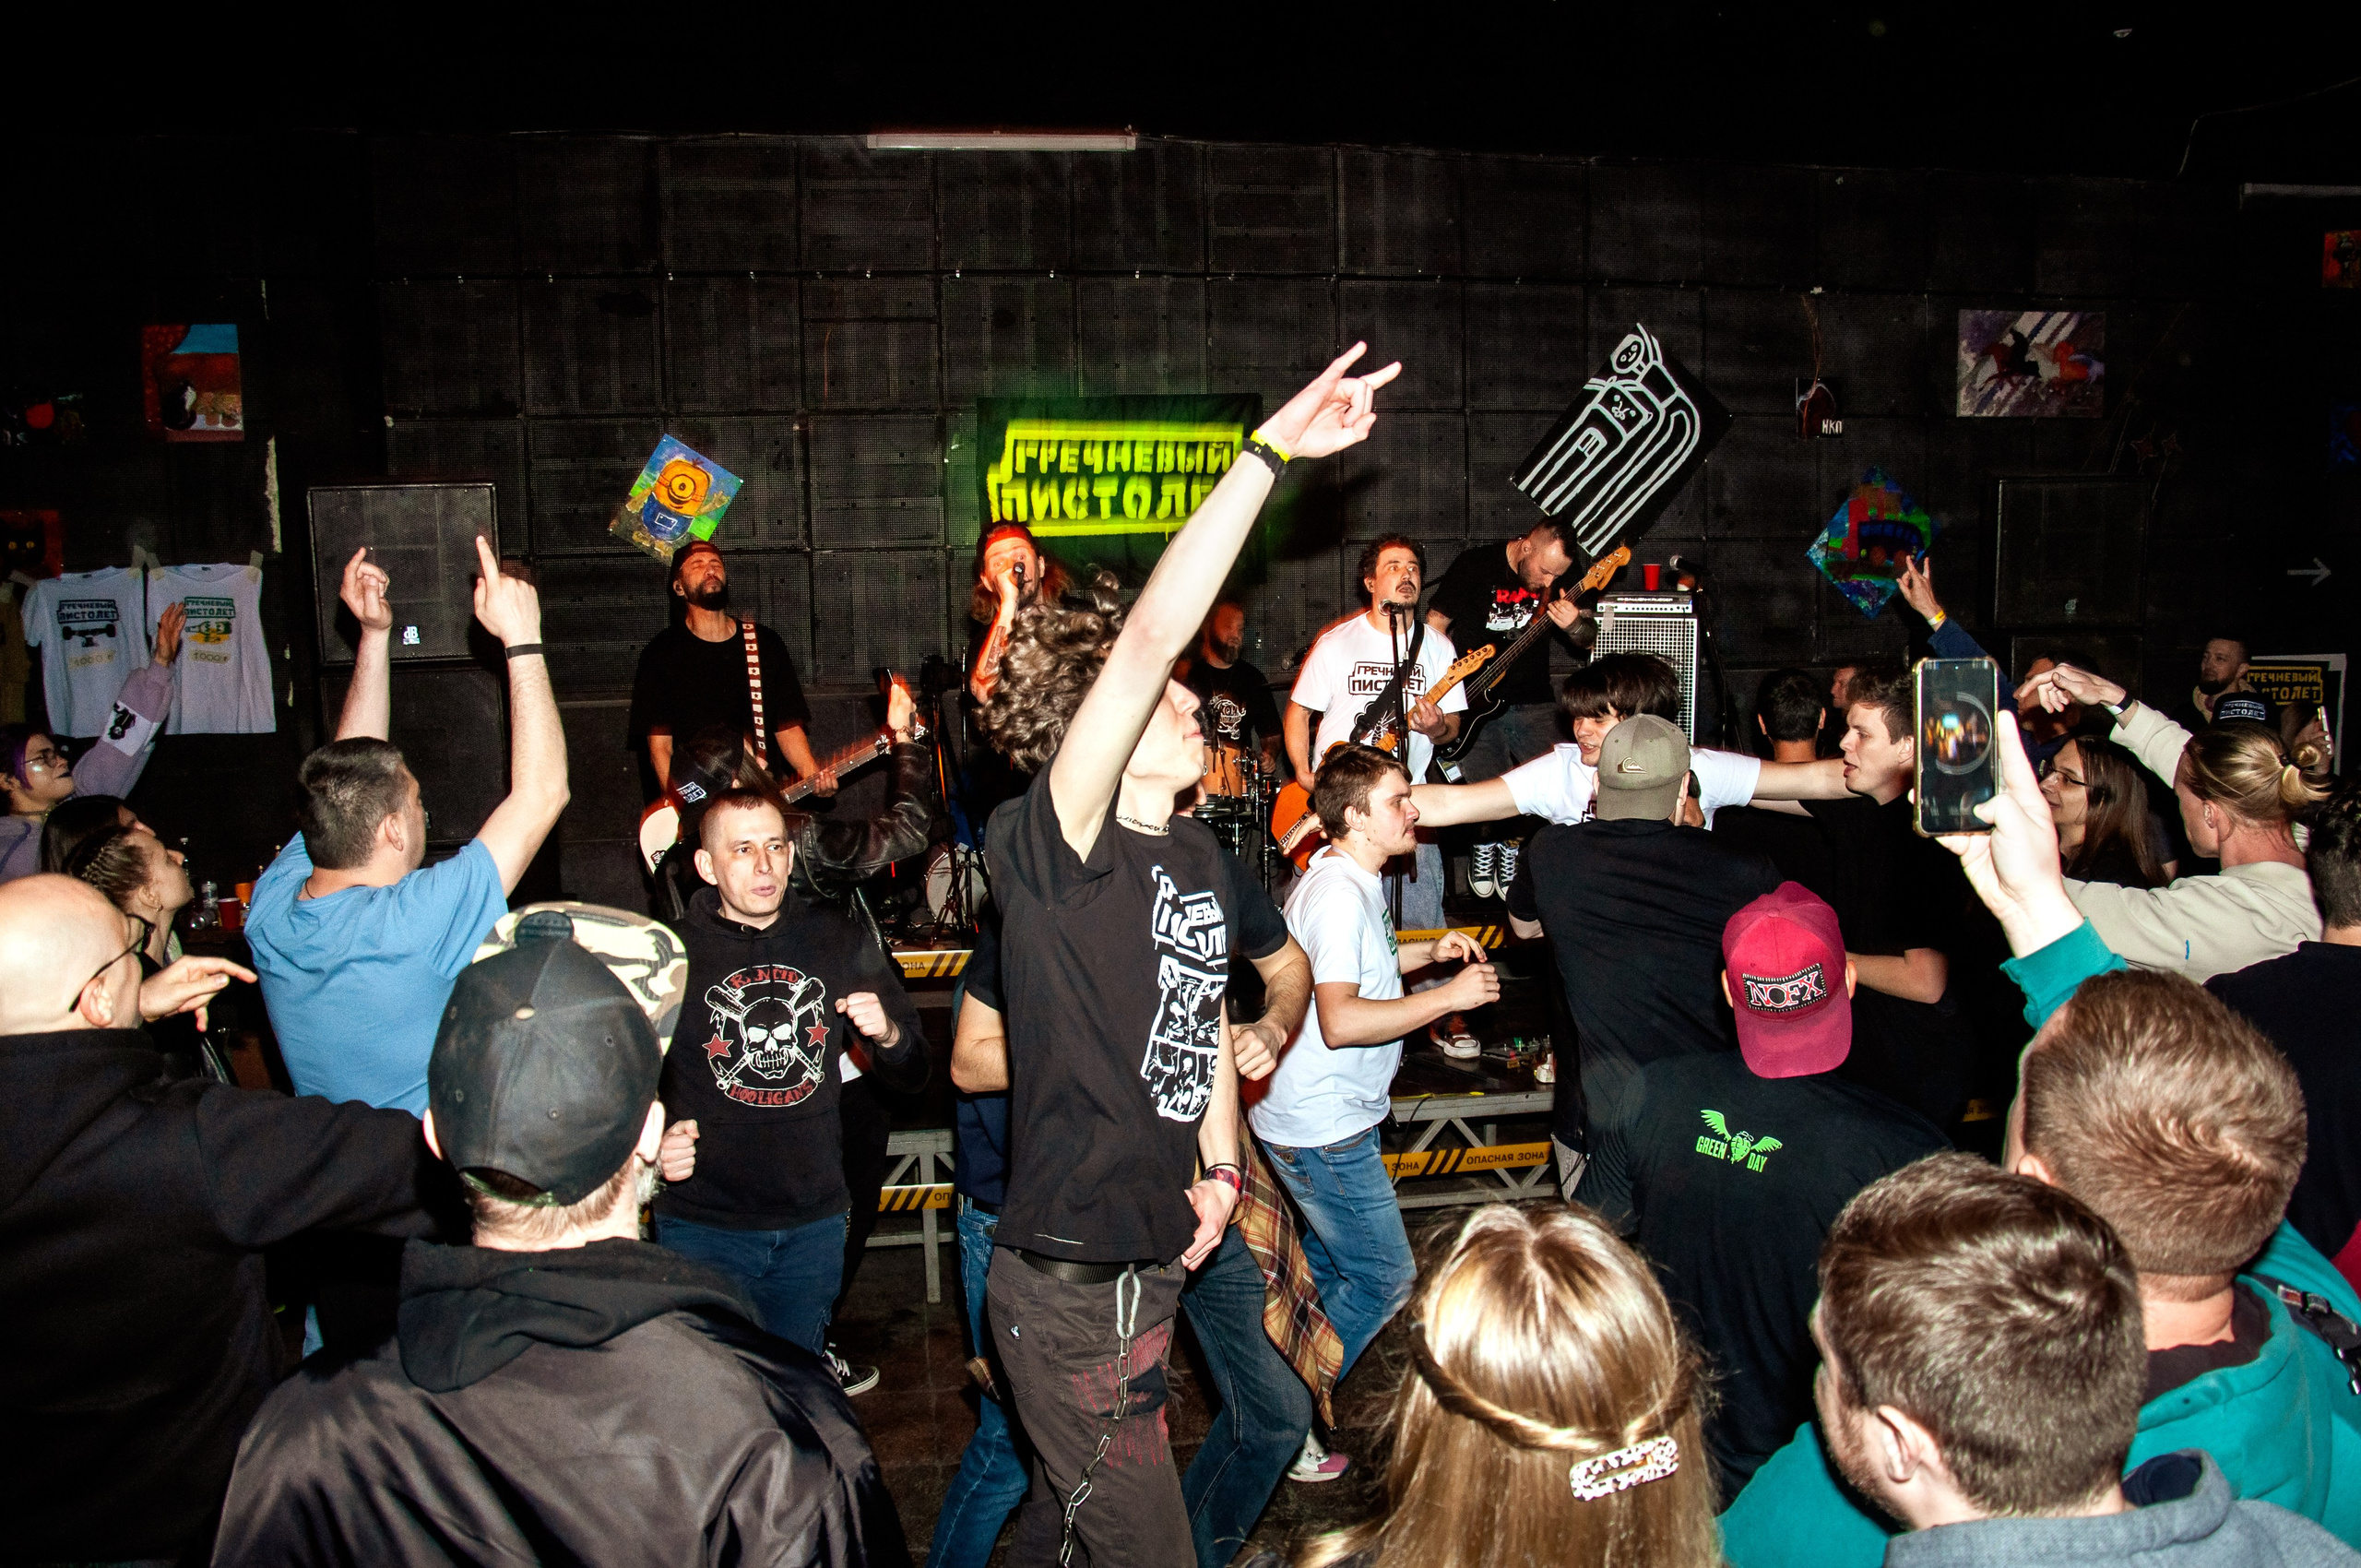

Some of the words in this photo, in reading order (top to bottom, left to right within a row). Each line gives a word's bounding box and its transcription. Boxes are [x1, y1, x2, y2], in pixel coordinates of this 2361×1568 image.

[1015, 440, 1231, 474] ГРЕЧНЕВЫЙ
[1001, 475, 1216, 521] ПИСТОЛЕ
[60, 611, 116, 621] ПИСТОЛЕТ
[1358, 665, 1421, 678] ГРЕЧНЙ
[2247, 671, 2319, 683] ГРЕЧНЕВЫЙ
[901, 961, 926, 971] ОНА
[1746, 970, 1823, 1008] NOFX
[730, 1079, 813, 1105] HOOLIGANS
[1466, 1153, 1513, 1165] ОПАСНАЯ
[1517, 1151, 1545, 1161] ЗОНА
[1695, 1135, 1727, 1159] GREEN
[1746, 1152, 1768, 1173] DAY
[1391, 1161, 1419, 1171] ЗОНА
